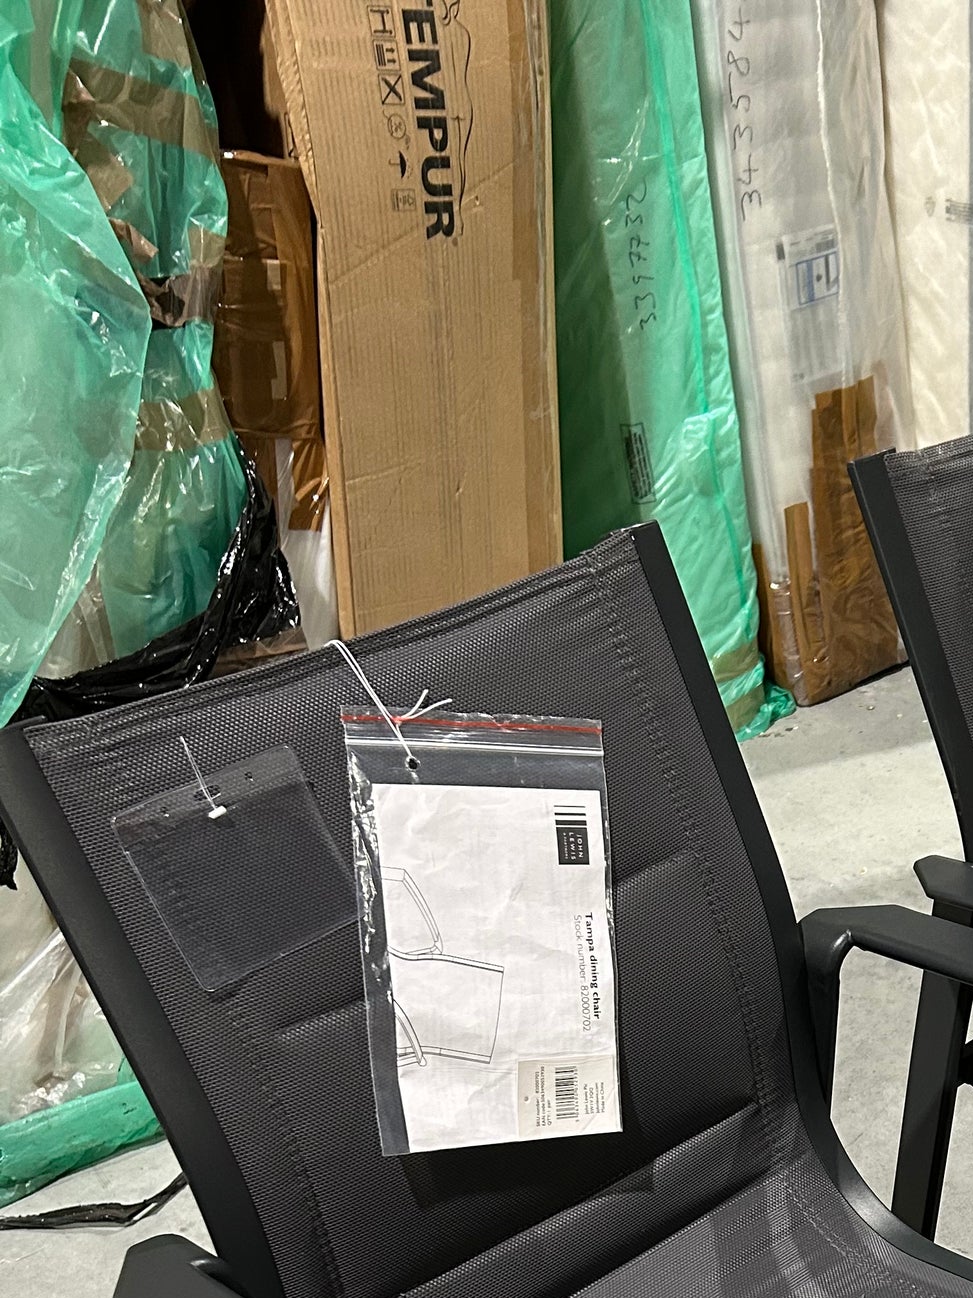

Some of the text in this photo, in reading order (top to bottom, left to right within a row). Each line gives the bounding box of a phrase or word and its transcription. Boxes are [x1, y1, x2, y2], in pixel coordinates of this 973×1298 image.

[402, 0, 455, 240] EMPUR
[569, 832, 577, 860] LEWIS
[576, 834, 584, 858] JOHN
[574, 914, 584, 942] Stock
[580, 985, 592, 1032] 82000702
[585, 912, 602, 1020] Tampa dining chair
